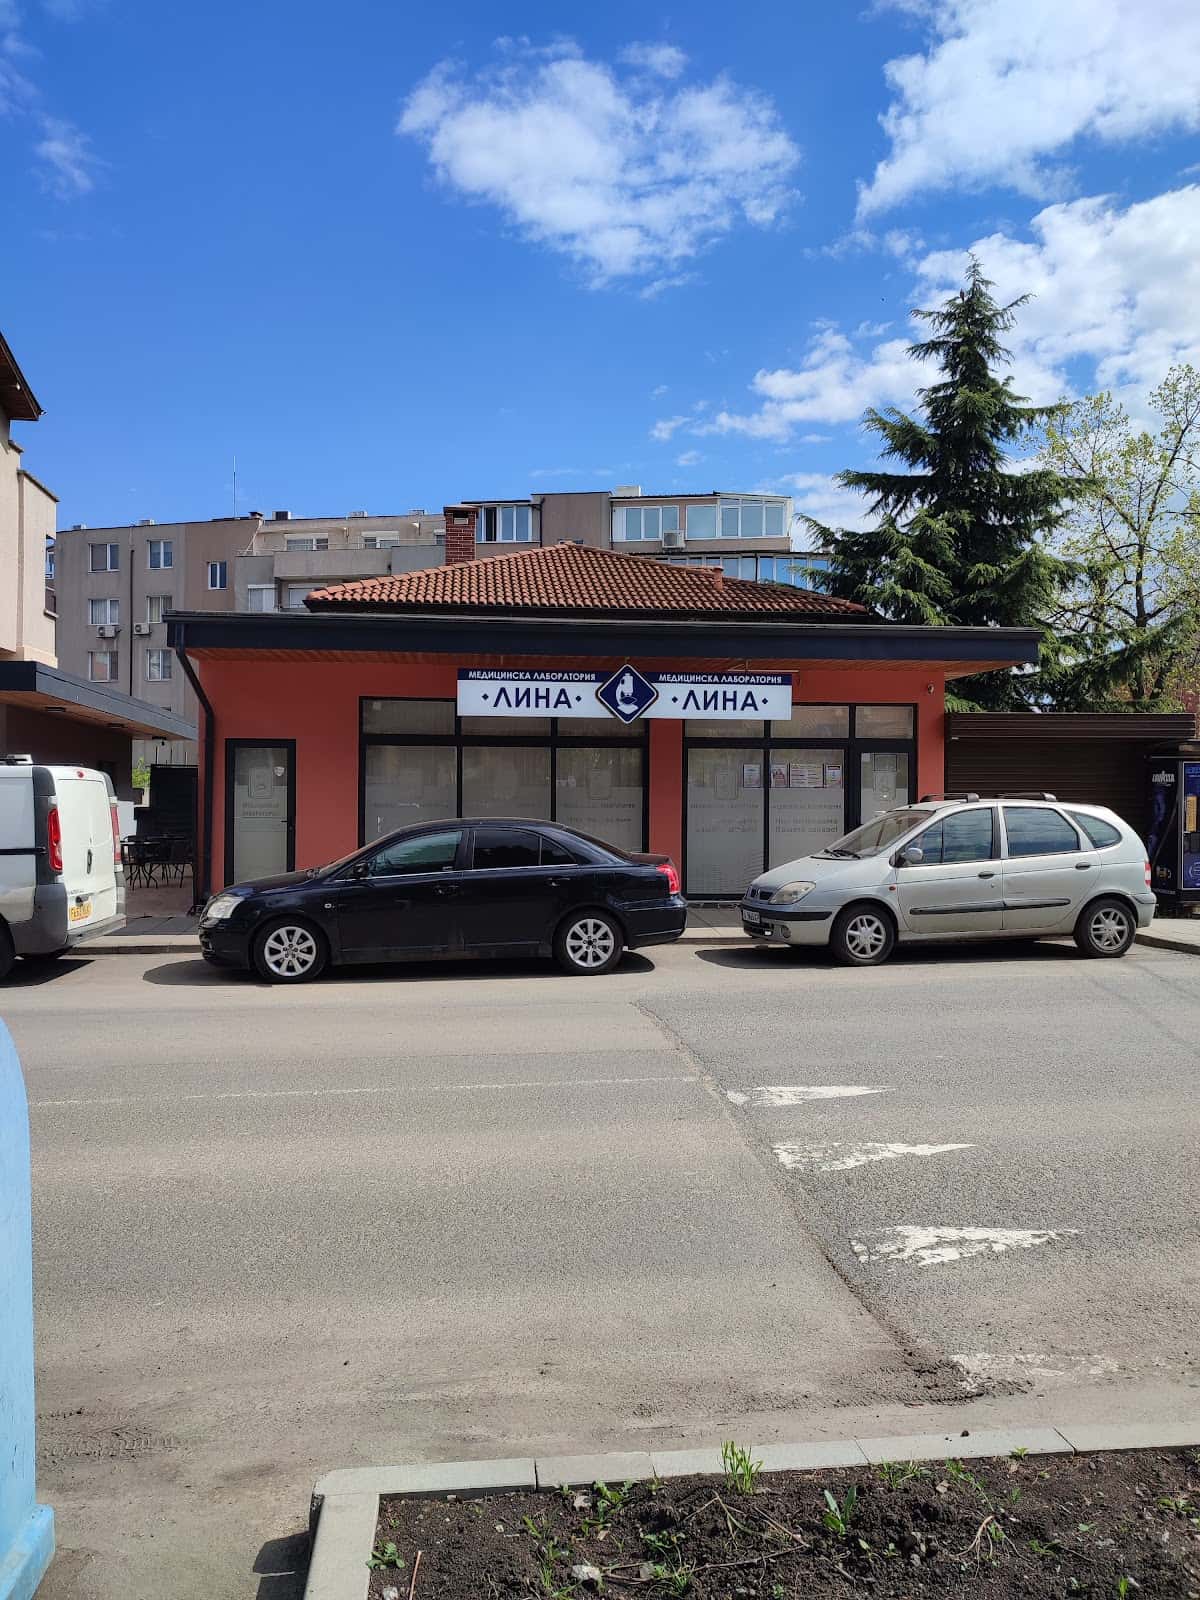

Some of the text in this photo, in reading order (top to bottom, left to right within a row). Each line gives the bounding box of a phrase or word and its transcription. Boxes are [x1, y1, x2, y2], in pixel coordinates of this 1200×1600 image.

[468, 671, 596, 682] МЕДИЦИНСКА ЛАБОРАТОРИЯ
[658, 674, 782, 684] МЕДИЦИНСКА ЛАБОРАТОРИЯ
[493, 687, 572, 708] ЛИНА
[681, 689, 759, 711] ЛИНА
